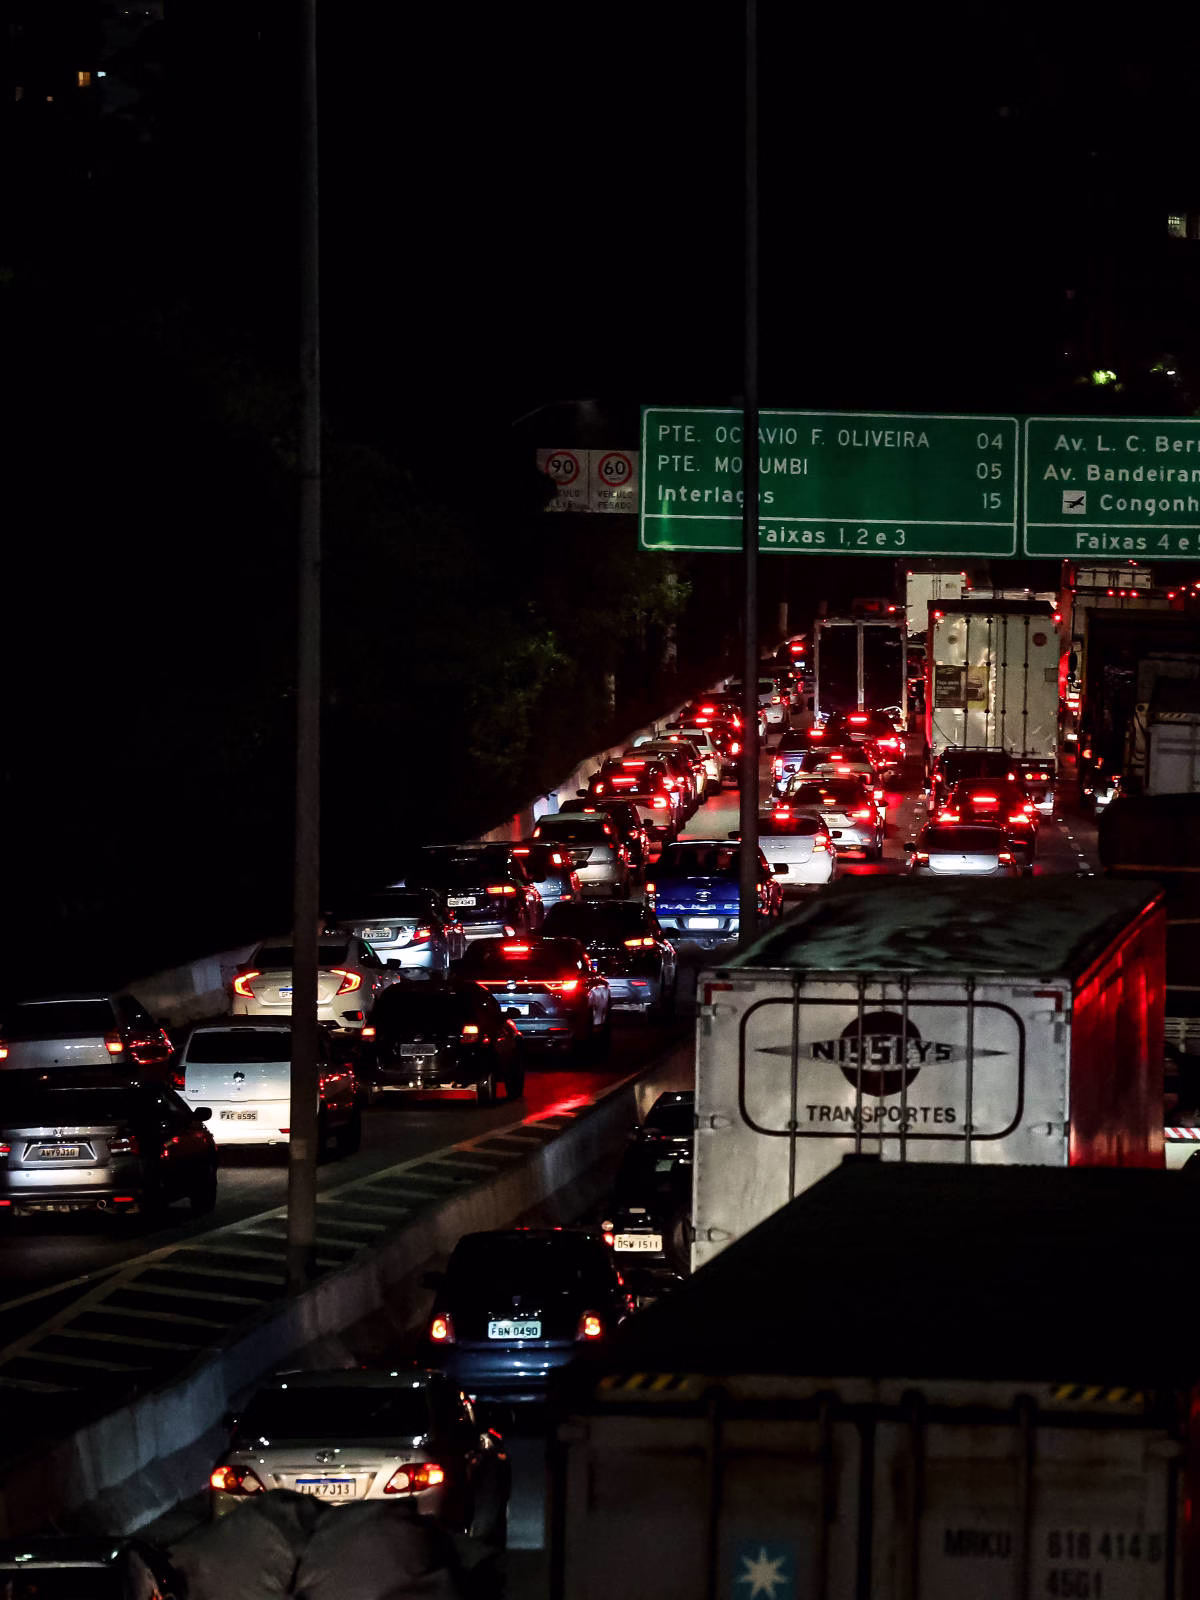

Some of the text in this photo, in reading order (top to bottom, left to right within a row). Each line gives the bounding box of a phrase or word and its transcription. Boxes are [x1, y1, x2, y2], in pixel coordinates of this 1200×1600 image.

[658, 425, 1003, 450] PTE. OCAVIO F. OLIVEIRA 04
[1054, 434, 1087, 452] Av.
[1097, 435, 1116, 452] L.
[1126, 435, 1147, 453] C.
[552, 459, 574, 474] 90
[604, 461, 626, 475] 60
[658, 455, 1003, 480] PTE. MOUMBI 05
[1043, 464, 1076, 481] Av.
[982, 493, 1002, 510] 15
[876, 533, 887, 545] e
[895, 529, 906, 546] 3
[1076, 532, 1148, 550] Faixas
[1157, 534, 1170, 550] 4
[1178, 537, 1190, 550] e
[806, 1105, 956, 1124] TRANSPORTES
